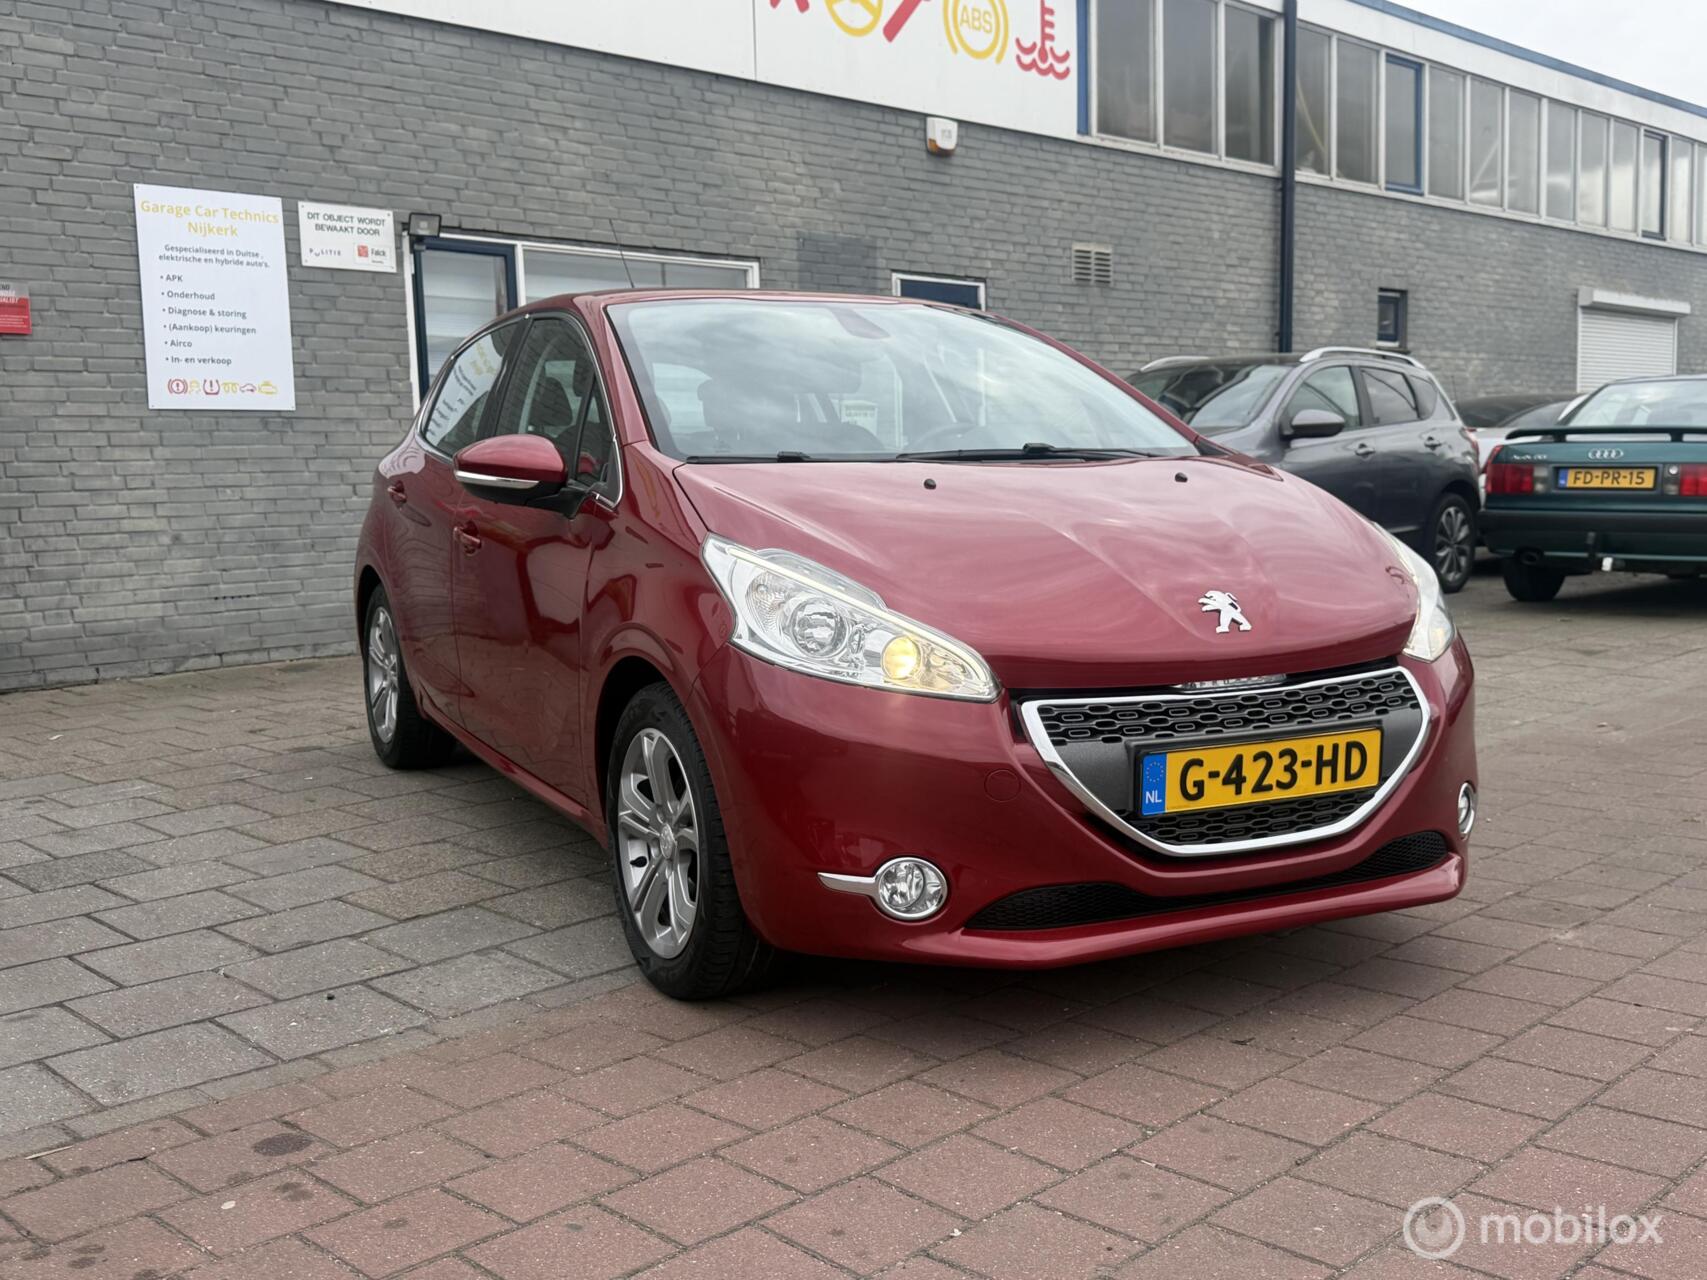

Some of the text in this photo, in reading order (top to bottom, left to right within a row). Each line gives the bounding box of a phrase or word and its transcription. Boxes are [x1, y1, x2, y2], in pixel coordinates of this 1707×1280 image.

[960, 4, 993, 34] ABS
[141, 200, 279, 224] Garage Car Technics
[307, 211, 386, 226] DIT OBJECT WORDT
[187, 221, 239, 237] Nijkerk
[315, 223, 380, 236] BEWAAKT DOOR
[164, 244, 225, 256] Gespecialiseerd
[226, 248, 234, 256] in
[235, 249, 260, 258] Duitse
[158, 254, 201, 263] elektrische
[203, 256, 214, 264] en
[215, 257, 244, 267] hybride
[165, 274, 183, 282] APK
[166, 290, 216, 300] Onderhoud
[168, 306, 247, 320] Diagnose & storing
[168, 323, 256, 336] (Aankoop) keuringen
[170, 339, 193, 347] Airco
[171, 356, 183, 364] In-
[197, 356, 232, 366] verkoop
[1572, 470, 1645, 486] FD-PR-15
[1179, 740, 1368, 802] G-423-HD
[1145, 790, 1163, 804] NL
